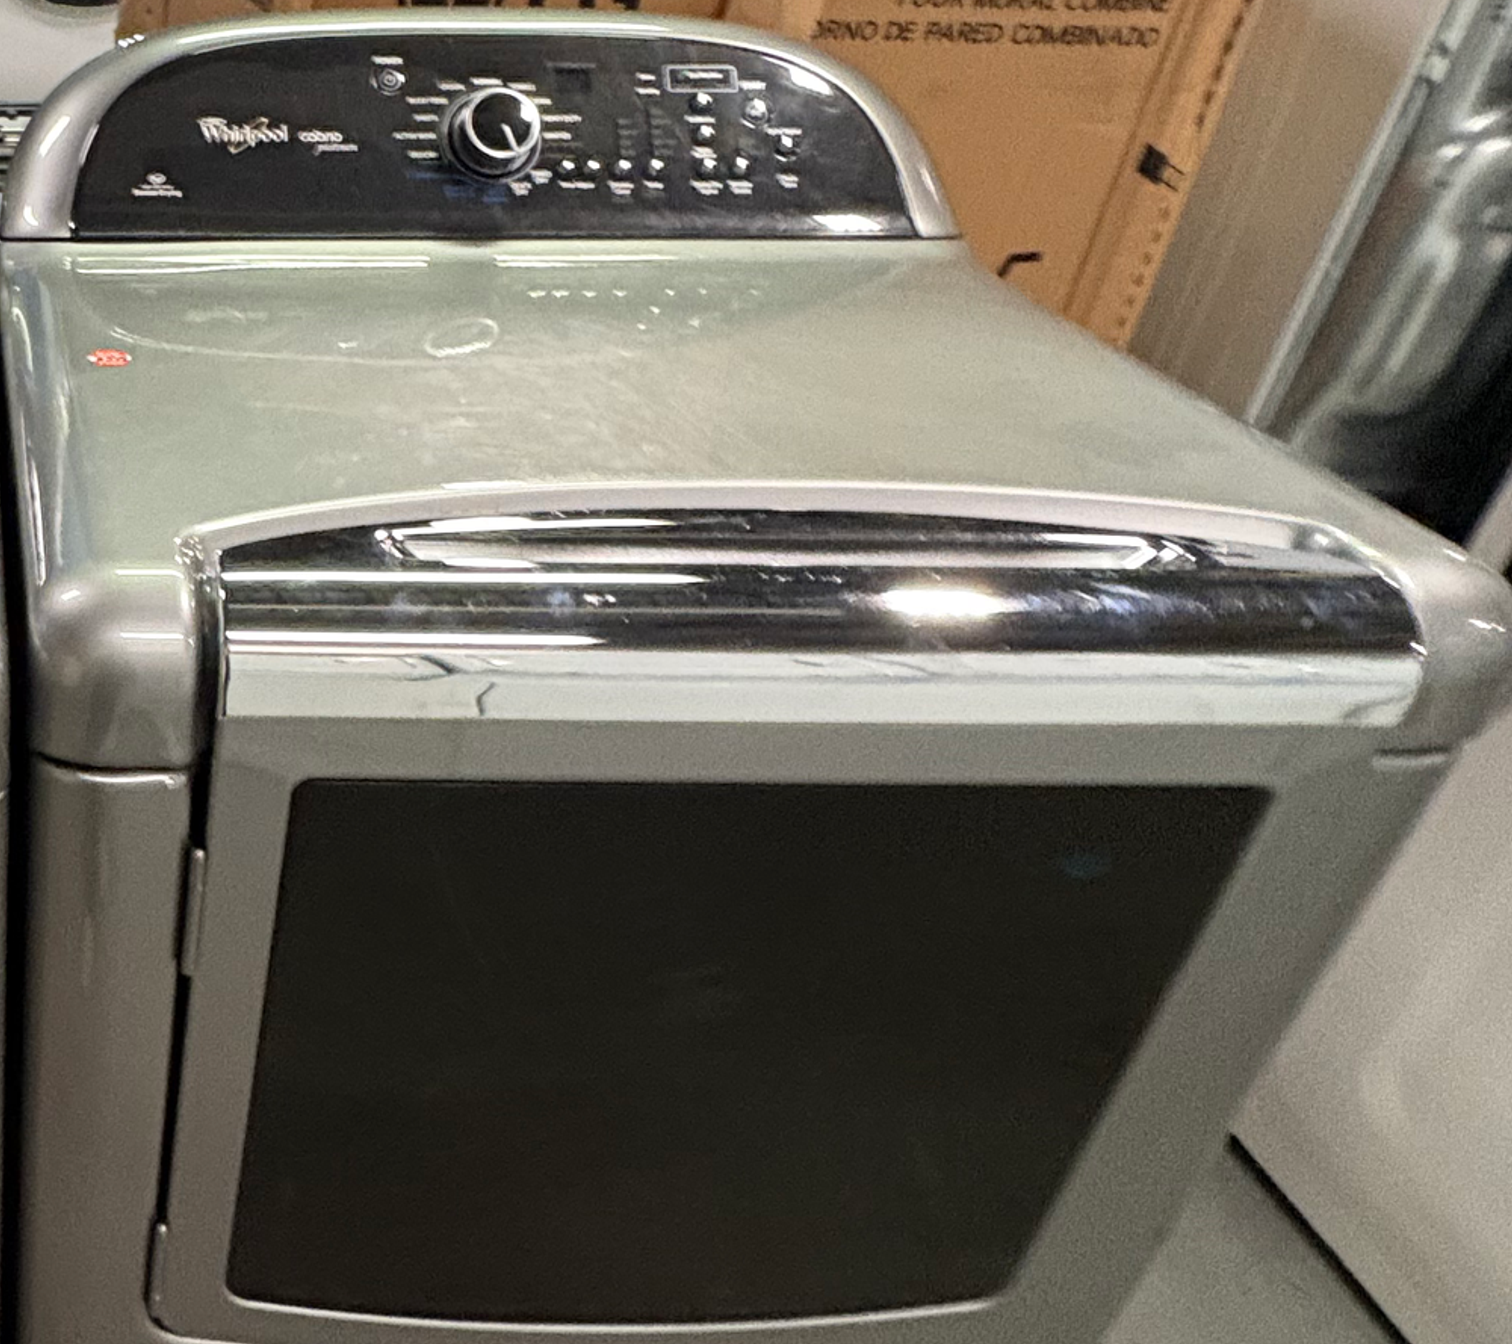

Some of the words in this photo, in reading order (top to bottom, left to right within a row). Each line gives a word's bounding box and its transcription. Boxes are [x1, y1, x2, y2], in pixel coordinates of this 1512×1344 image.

[810, 19, 879, 42] ORNO
[884, 20, 919, 43] DE
[923, 21, 1004, 45] PARED
[1010, 23, 1160, 48] COMBINADO
[197, 117, 288, 147] Whirlpool
